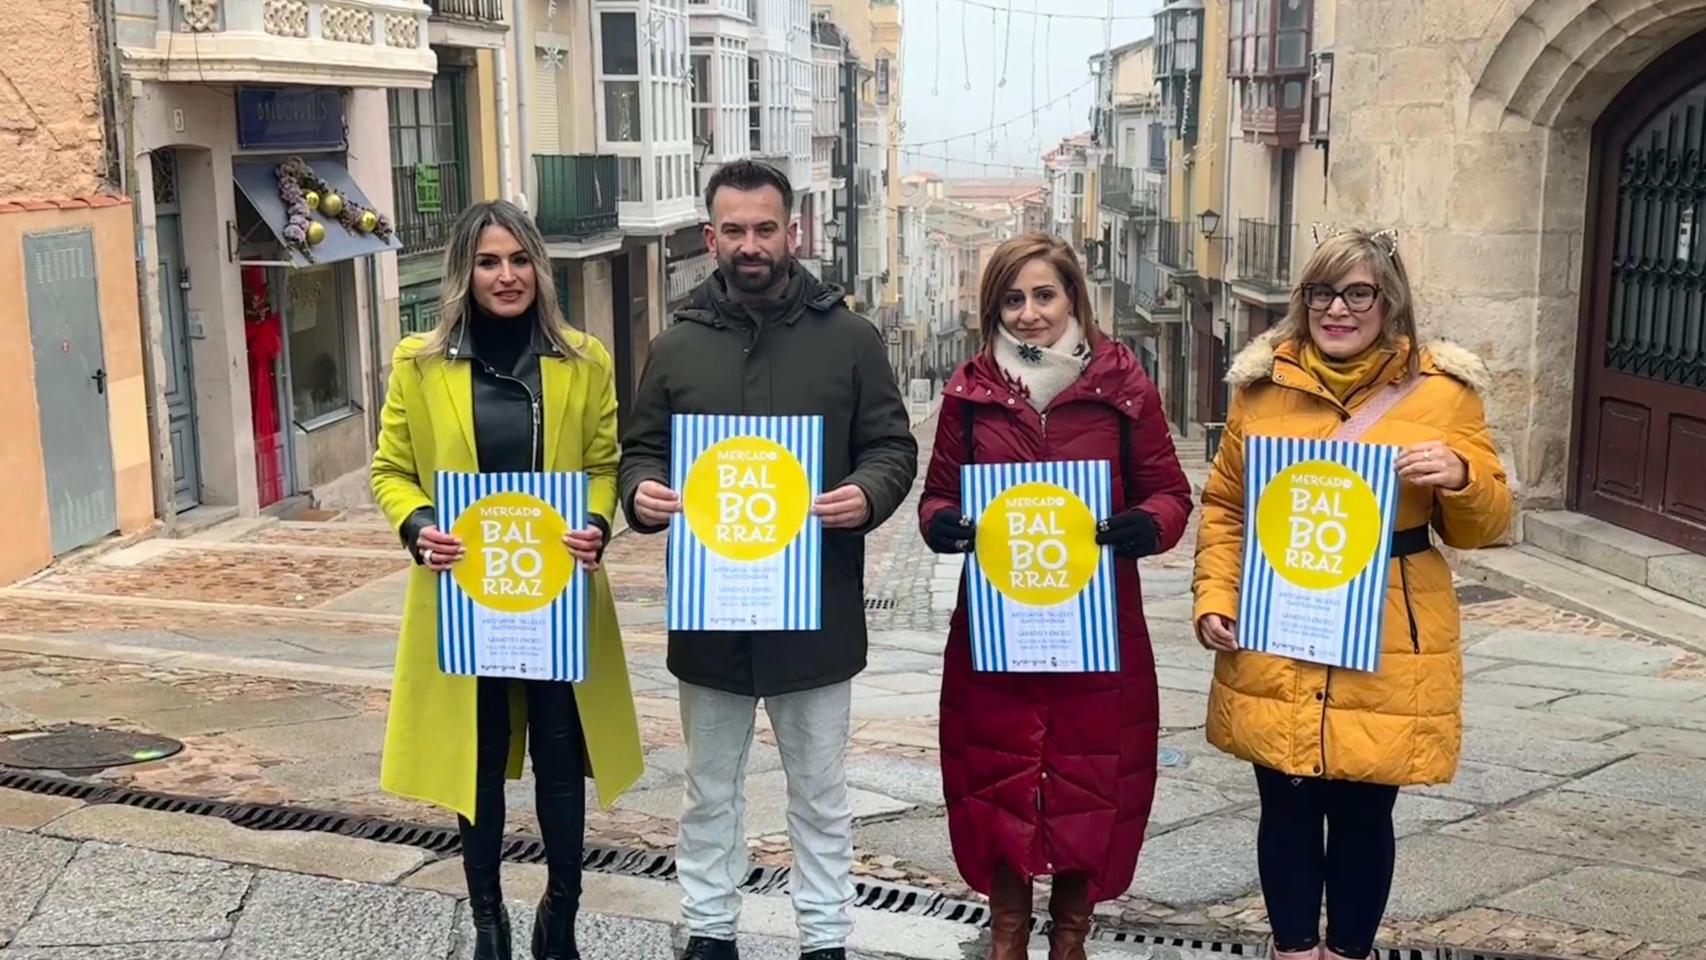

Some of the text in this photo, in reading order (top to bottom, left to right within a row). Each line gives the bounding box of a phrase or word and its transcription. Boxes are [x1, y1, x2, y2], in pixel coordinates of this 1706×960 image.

[716, 450, 779, 461] MERCADO
[716, 464, 776, 489] BAL
[1290, 473, 1353, 489] MERCADO
[480, 506, 542, 517] MERCADO
[716, 492, 777, 524] BO
[1005, 496, 1065, 507] MERCADO
[1290, 488, 1349, 518] BAL
[480, 520, 541, 544] BAL
[716, 524, 778, 542] RRAZ
[1006, 512, 1065, 536] BAL
[1289, 516, 1347, 553] BO
[481, 547, 543, 578] BO
[1007, 538, 1069, 570] BO
[1285, 548, 1344, 575] RRAZ
[481, 578, 544, 597] RRAZ
[1009, 570, 1070, 588] RRAZ
